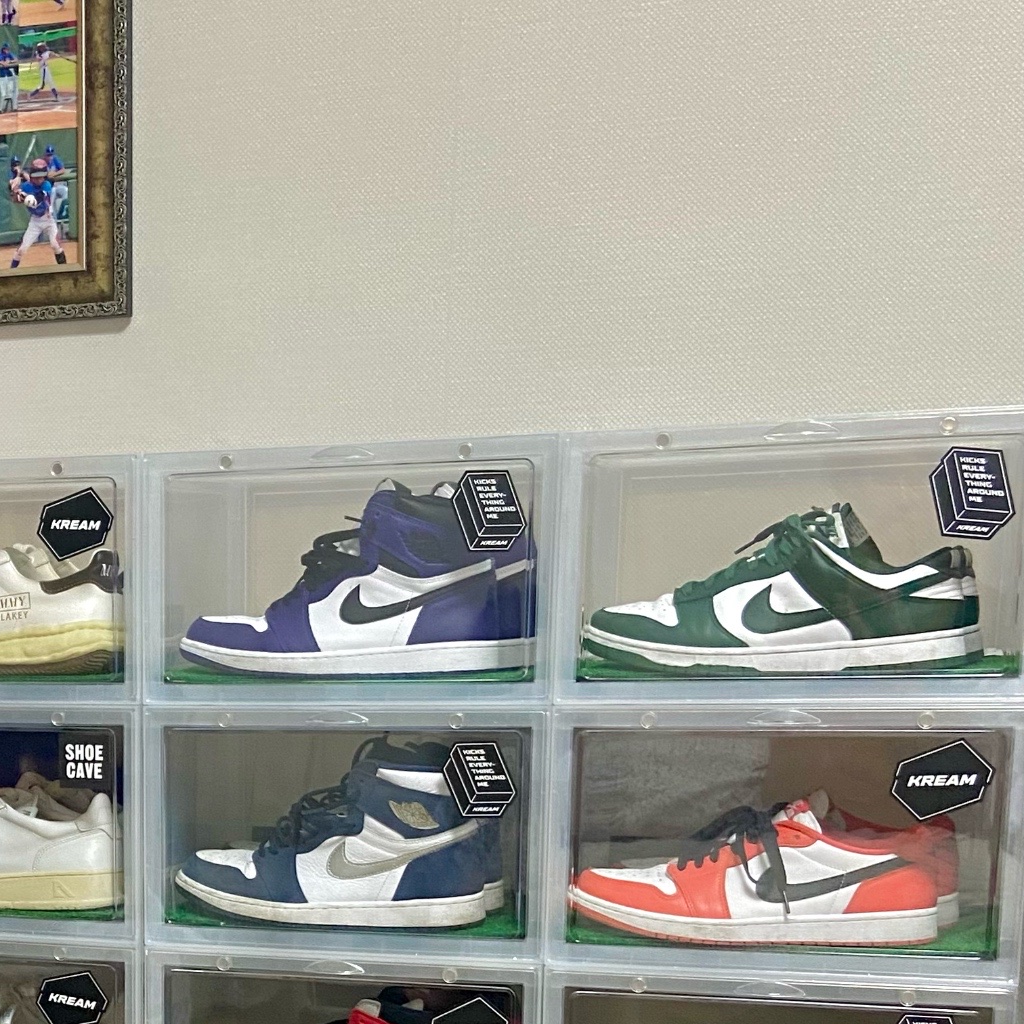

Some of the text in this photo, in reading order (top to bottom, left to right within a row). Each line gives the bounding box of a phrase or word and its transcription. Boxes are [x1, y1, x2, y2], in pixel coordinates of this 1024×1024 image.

[961, 464, 986, 472] RULE
[963, 472, 996, 480] EVERY-
[965, 480, 993, 488] THING
[50, 518, 102, 531] KREAM
[65, 743, 104, 761] SHOE
[66, 761, 103, 779] CAVE
[907, 773, 977, 788] KREAM
[48, 992, 97, 1011] KREAM
